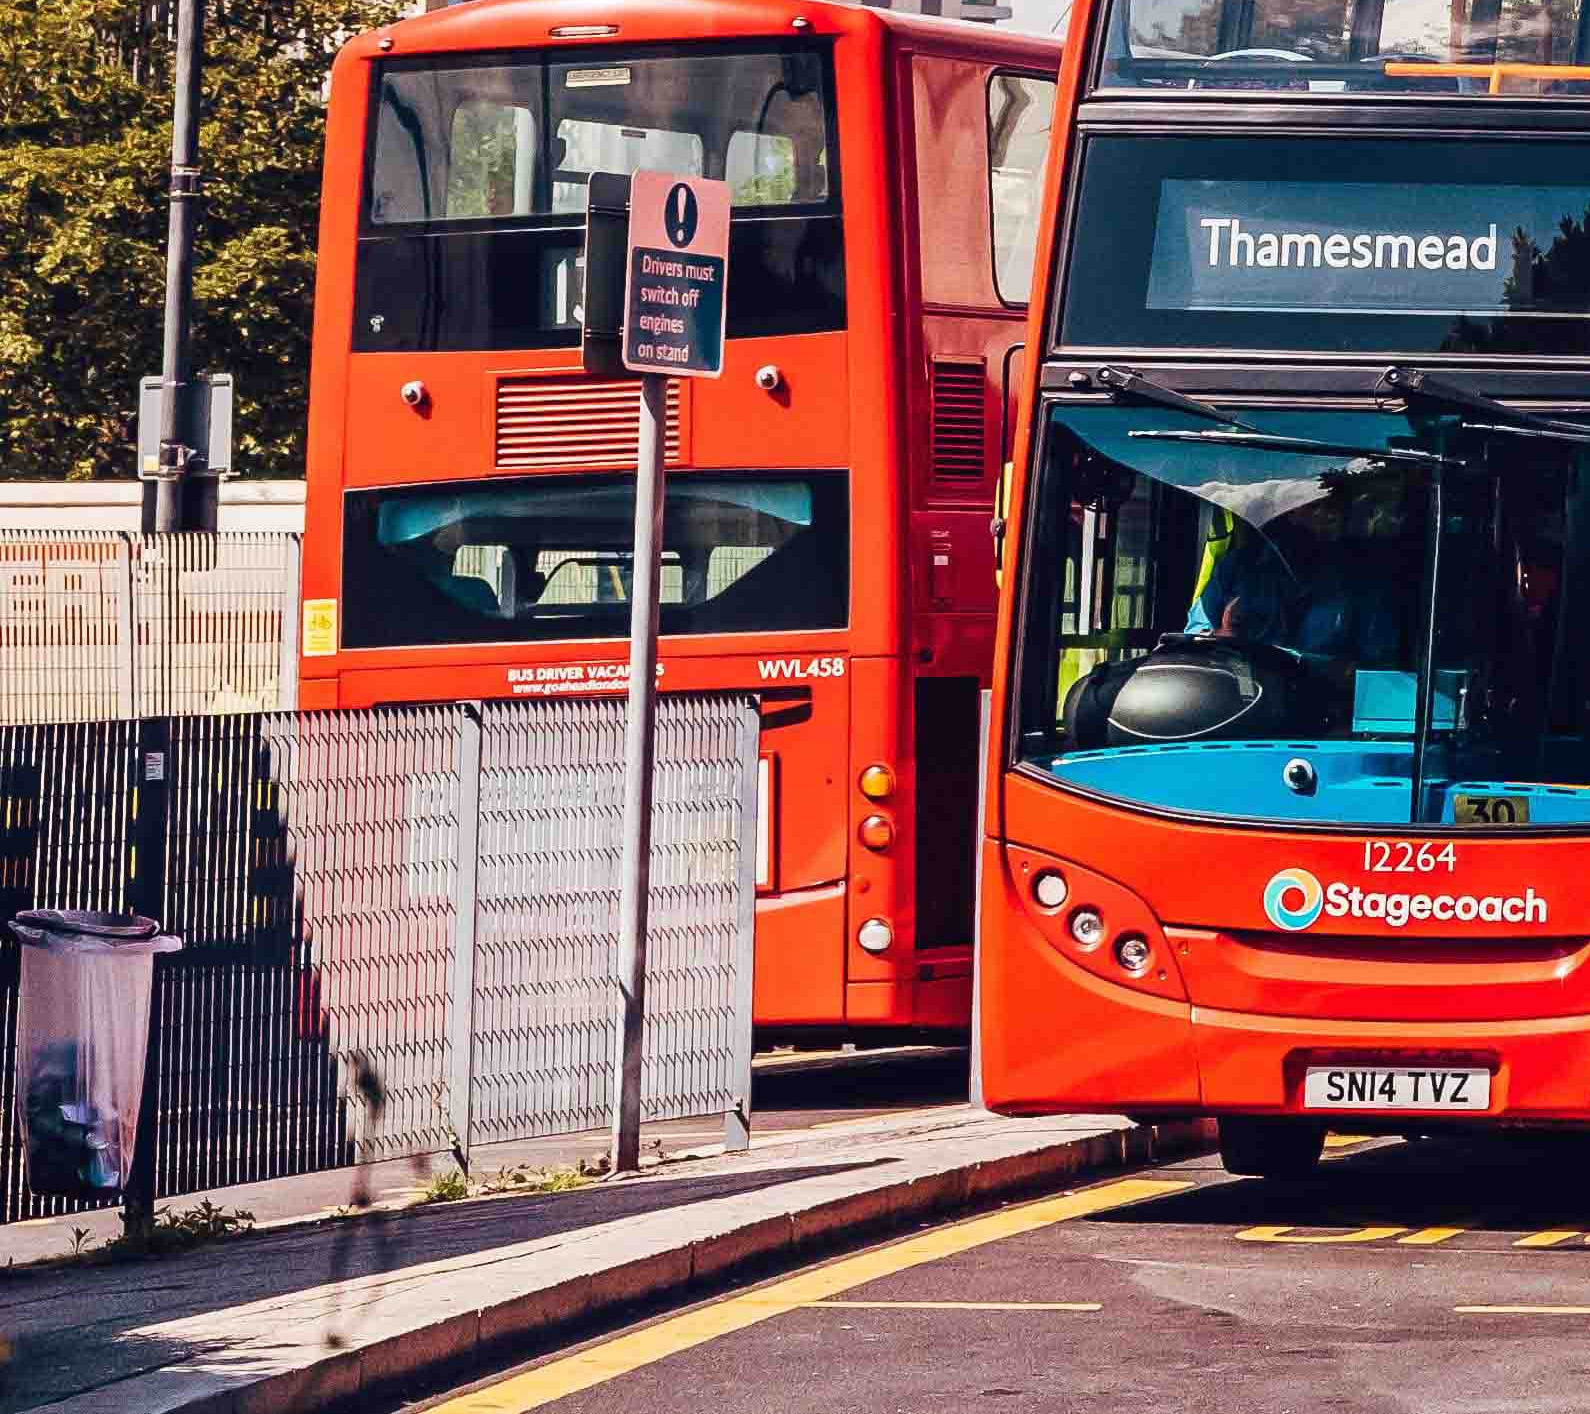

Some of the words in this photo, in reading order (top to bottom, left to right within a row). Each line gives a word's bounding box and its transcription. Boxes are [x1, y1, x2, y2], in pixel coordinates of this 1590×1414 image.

[1200, 217, 1497, 270] Thamesmead
[641, 255, 683, 279] Drivers
[685, 263, 715, 282] must
[640, 285, 679, 306] switch
[682, 288, 700, 308] off
[638, 313, 684, 337] engines
[637, 344, 652, 359] on
[656, 342, 689, 363] stand
[508, 668, 535, 682] BUS
[536, 666, 584, 681] DRIVER
[757, 657, 845, 679] WVL458
[1466, 798, 1515, 824] 30
[1363, 840, 1456, 872] 12264
[1324, 881, 1548, 927] Stagecoach
[1326, 1071, 1397, 1103] SN14
[1407, 1072, 1470, 1103] TVZ
